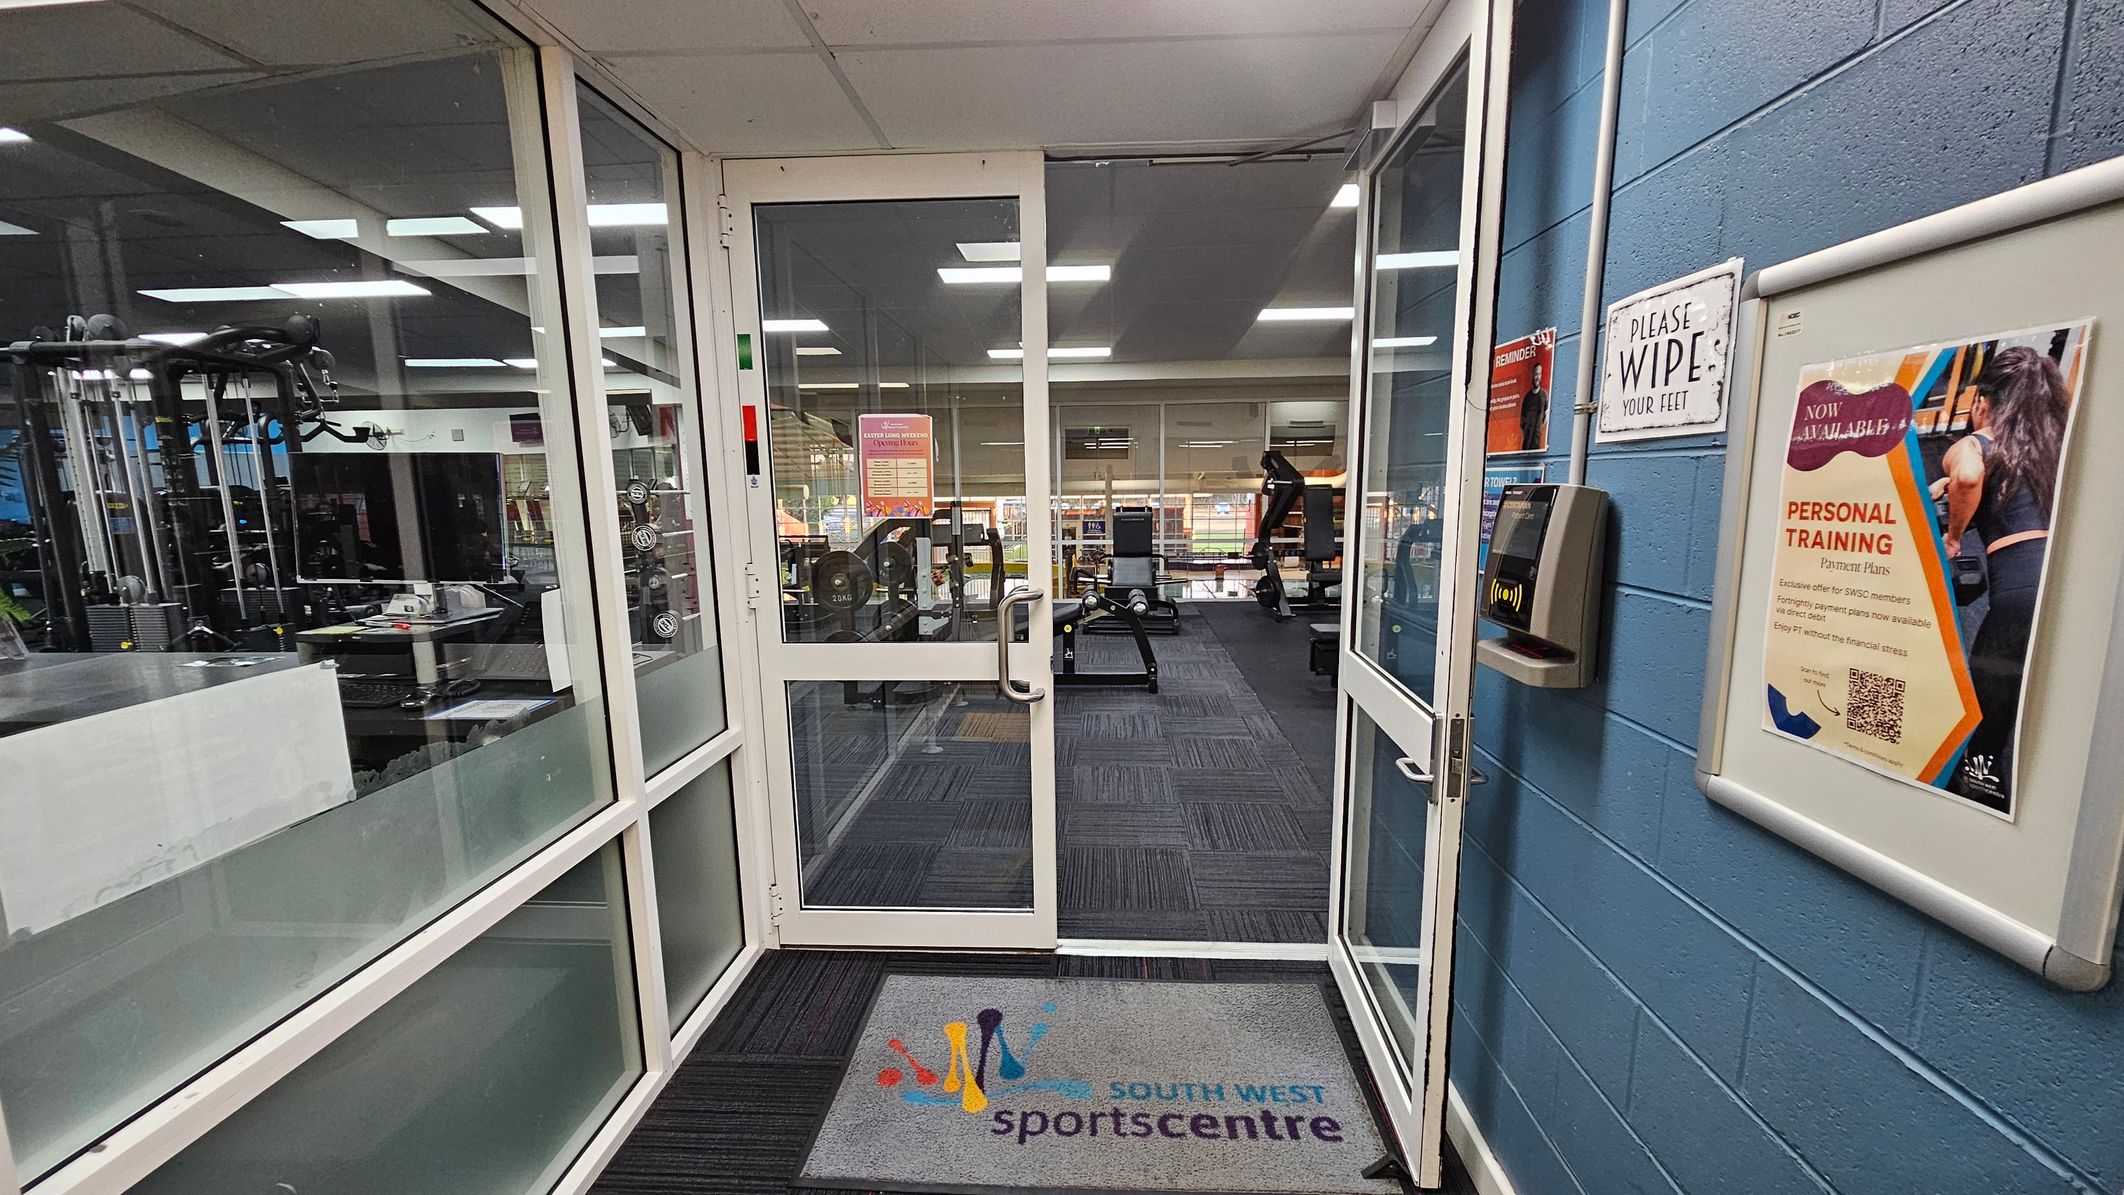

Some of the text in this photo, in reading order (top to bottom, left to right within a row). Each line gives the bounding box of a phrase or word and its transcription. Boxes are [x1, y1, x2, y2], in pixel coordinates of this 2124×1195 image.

[1630, 302, 1692, 343] PLEASE
[1495, 345, 1537, 368] REMINDER
[1620, 331, 1704, 394] WIPE
[1623, 390, 1688, 417] YOUR FEET
[1804, 401, 1843, 421] NOW
[1801, 418, 1889, 440] AVAILABLE
[873, 439, 919, 448] Opening Hours
[1787, 501, 1897, 525] PERSONAL
[1786, 528, 1893, 555] TRAINING
[1820, 557, 1891, 576] Payment Plans
[832, 593, 853, 602] 20KG
[1779, 578, 1911, 606] Exclusive offer for SWSC members
[1776, 606, 1826, 622] via direct debit
[1777, 595, 1932, 629] Fortnightly payment plans now available
[1773, 621, 1908, 657] Enjoy PT without the financial stress
[1108, 1081, 1325, 1104] SOUTH WEST
[990, 1106, 1343, 1146] sportscentre
